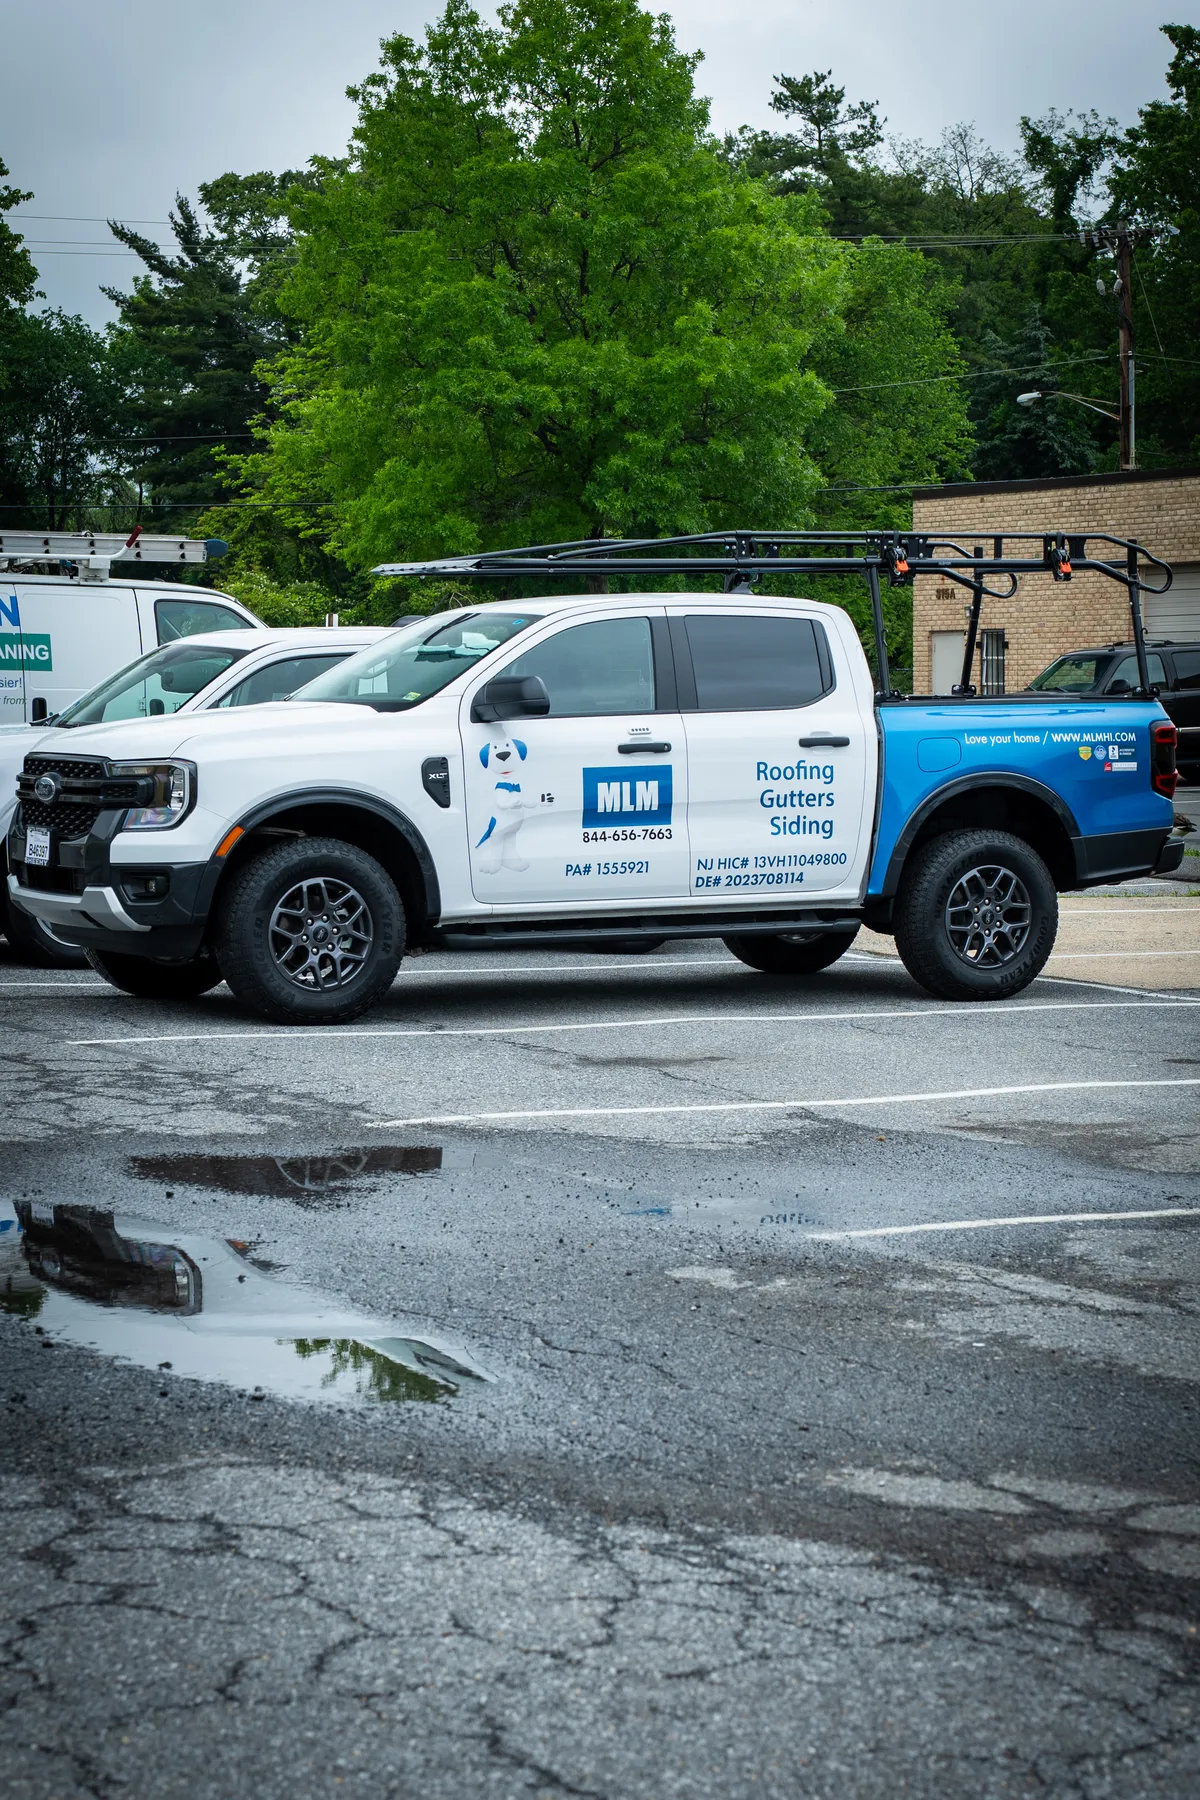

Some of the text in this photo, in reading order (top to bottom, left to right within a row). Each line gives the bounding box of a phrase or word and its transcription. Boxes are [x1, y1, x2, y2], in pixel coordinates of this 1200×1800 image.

[964, 733, 988, 744] Love
[990, 735, 1011, 747] your
[1013, 731, 1040, 744] home
[1051, 732, 1137, 743] WWW.MLMHI.COM
[428, 772, 448, 780] XLT
[756, 760, 834, 785] Roofing
[597, 780, 659, 813] MLM
[760, 788, 835, 808] Gutters
[770, 815, 834, 839] Siding
[582, 828, 673, 844] 844-656-7663
[565, 861, 649, 876] PA# 1555921
[697, 852, 847, 871] NJ HIC# 13VH11049800
[695, 872, 804, 888] DE# 2023708114
